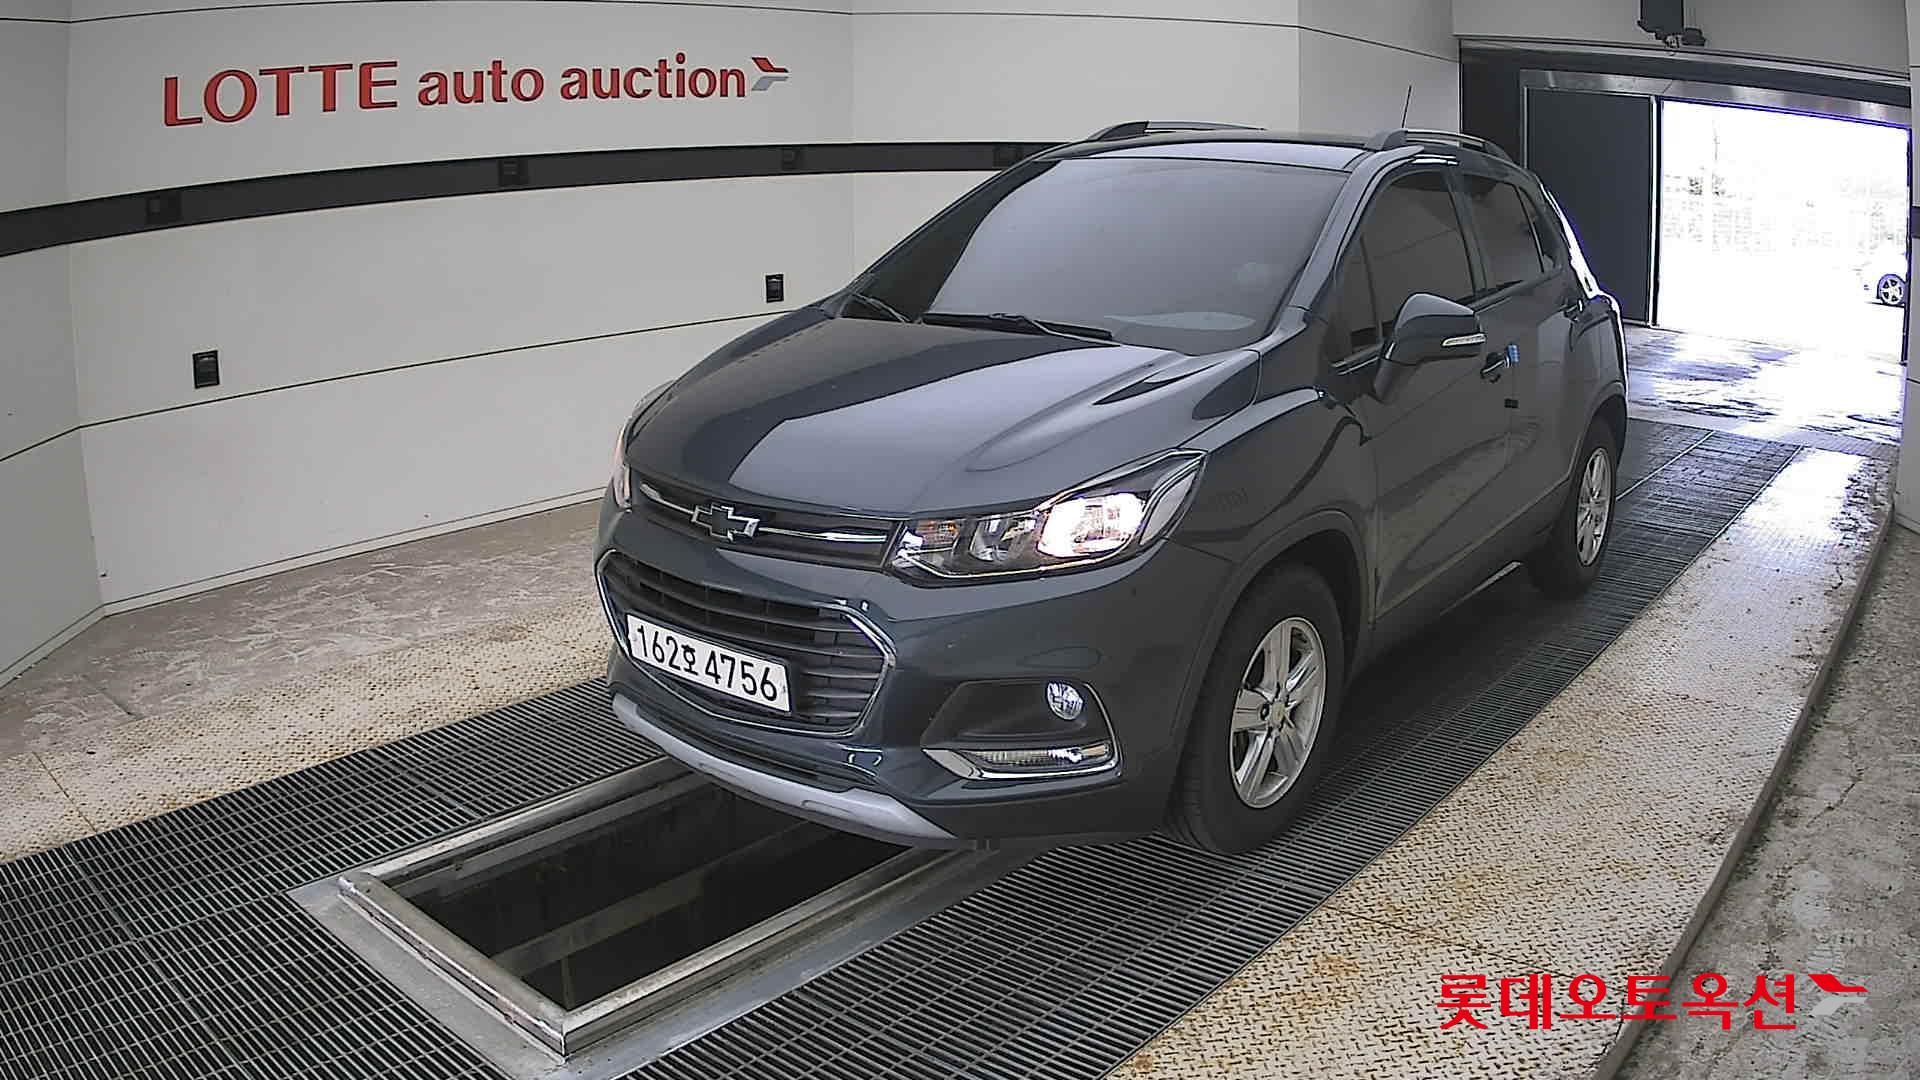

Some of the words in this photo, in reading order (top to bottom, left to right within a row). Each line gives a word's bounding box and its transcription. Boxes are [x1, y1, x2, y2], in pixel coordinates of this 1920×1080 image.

[164, 62, 398, 126] LOTTE
[418, 60, 544, 105] auto
[560, 53, 747, 100] auction
[637, 625, 698, 676] 162호
[705, 650, 778, 702] 4756
